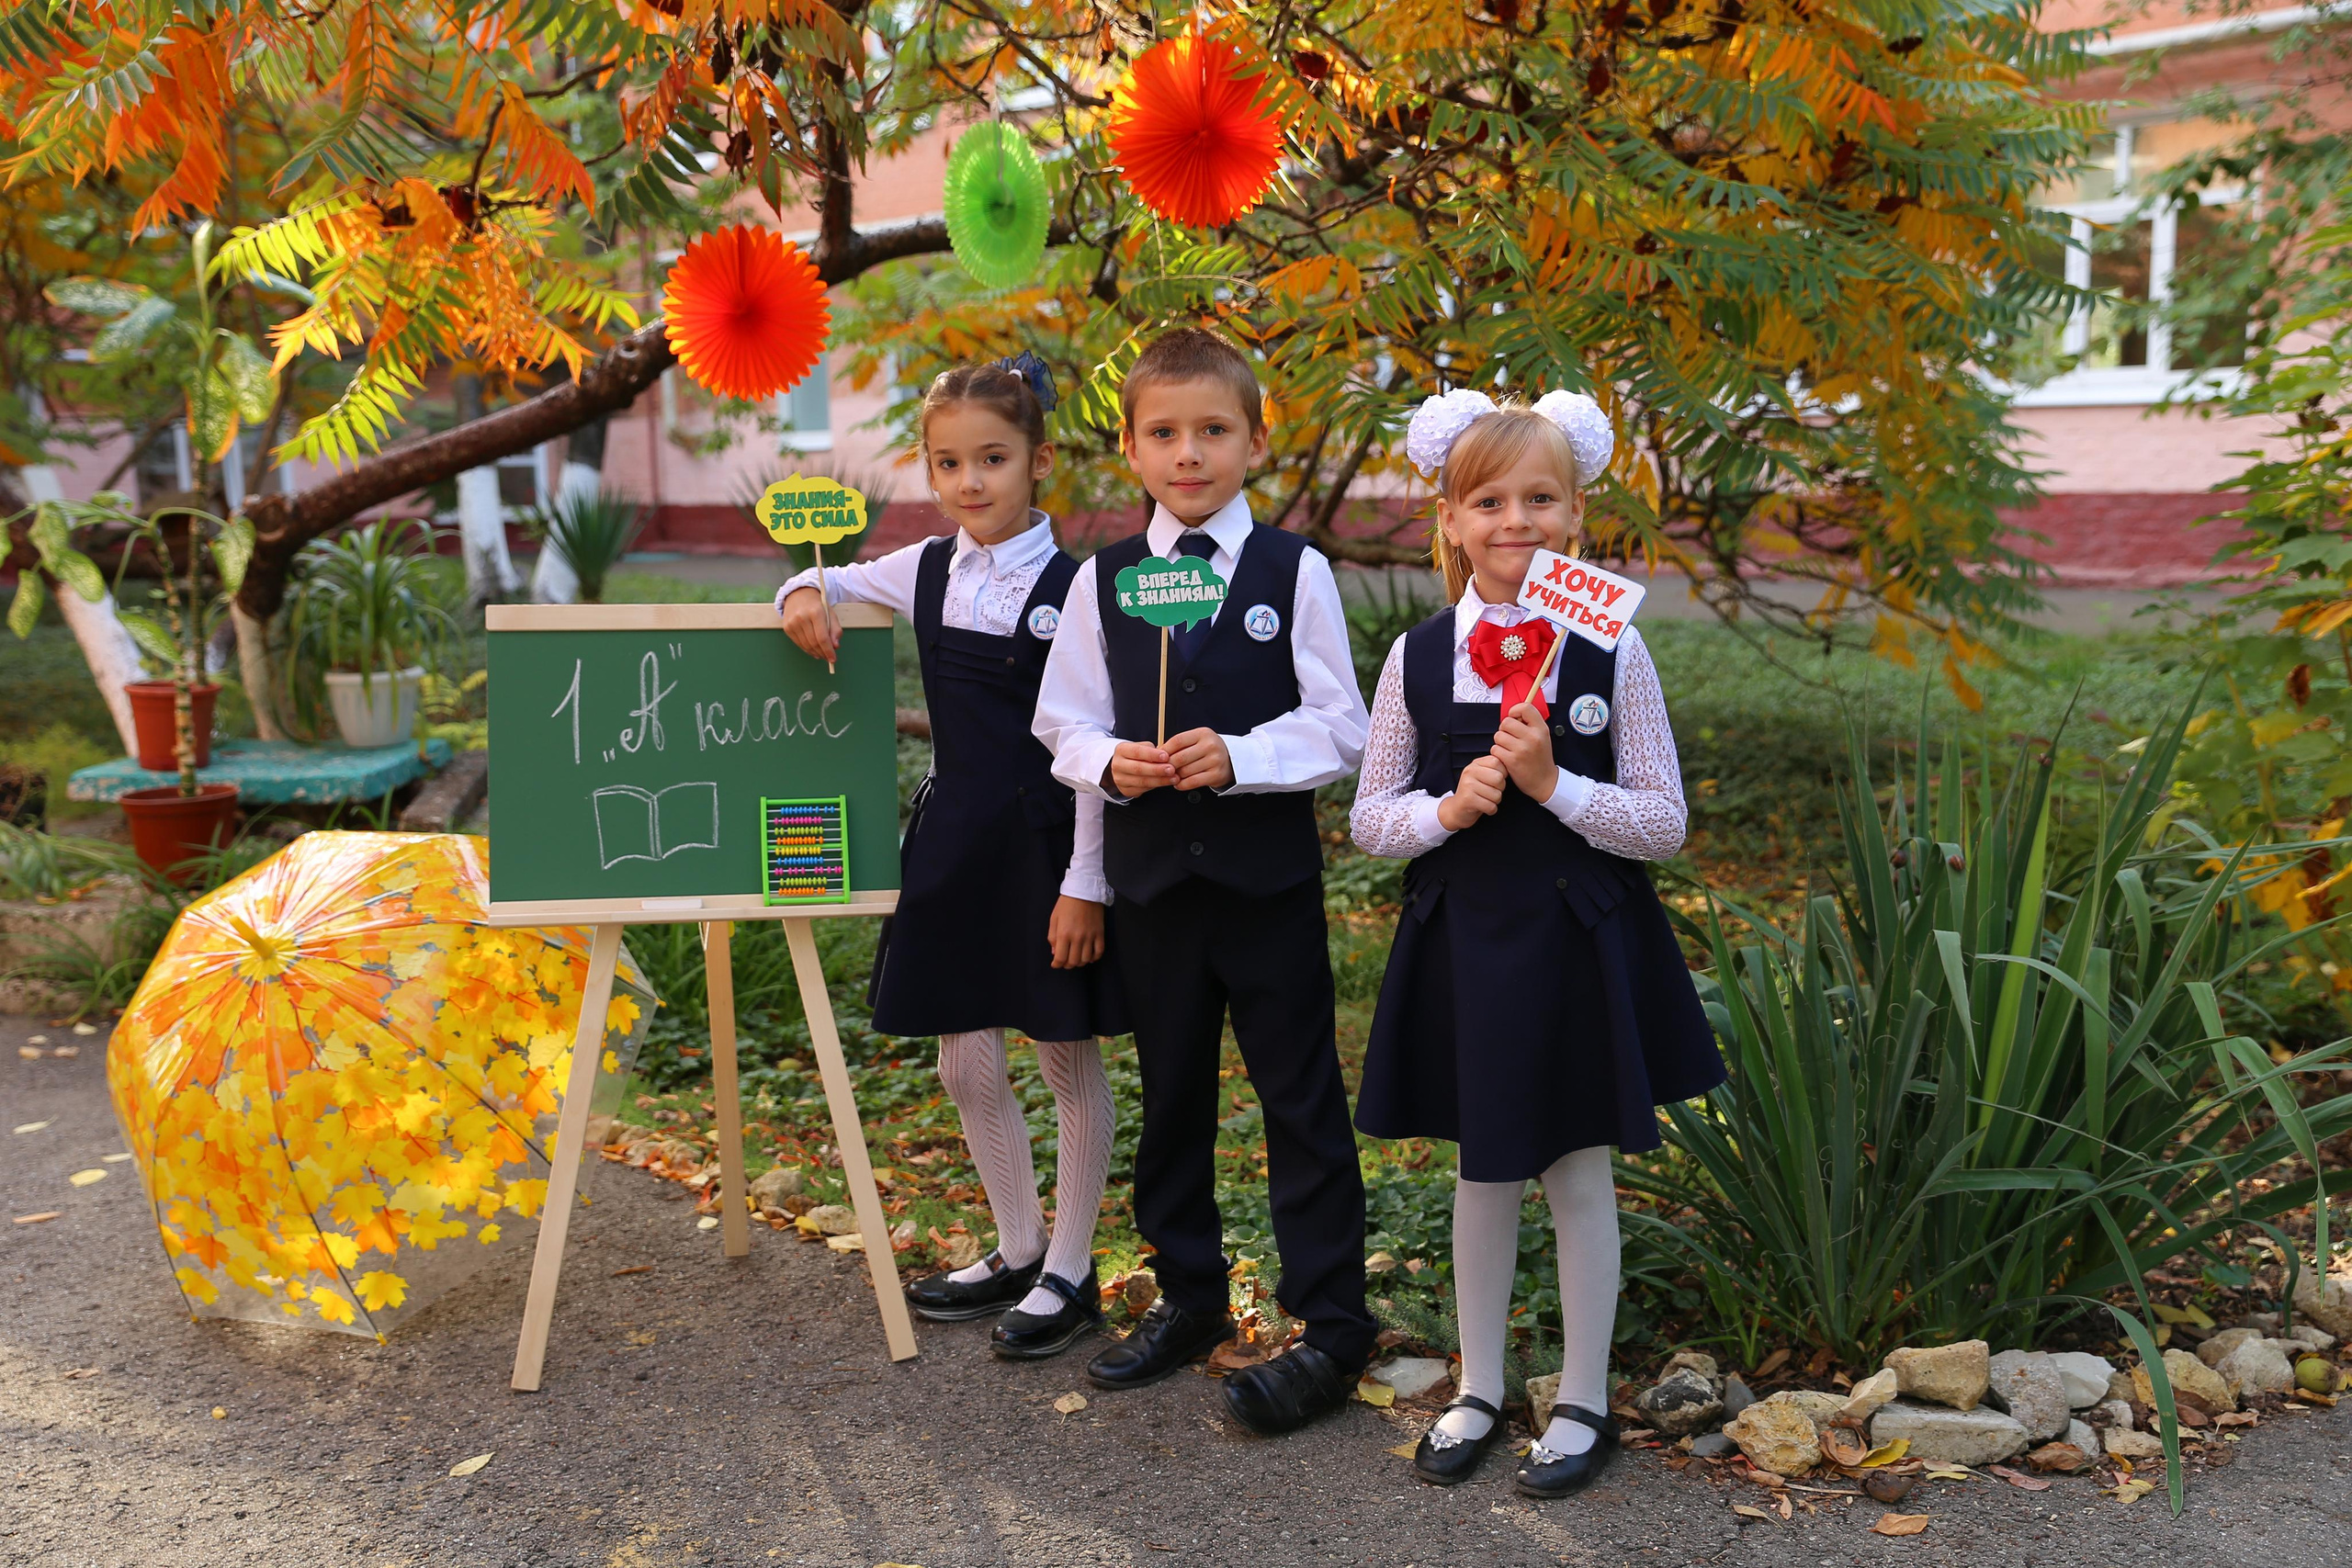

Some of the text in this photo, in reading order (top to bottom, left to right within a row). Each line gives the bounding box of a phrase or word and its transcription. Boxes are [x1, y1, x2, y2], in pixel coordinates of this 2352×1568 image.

[772, 490, 853, 510] ЗНАНИЯ-
[769, 509, 859, 530] ЭТО СИЛА
[1137, 570, 1204, 590] ВПЕРЕД
[1544, 558, 1626, 608] ХОЧУ
[1120, 584, 1224, 607] К ЗНАНИЯМ!
[1524, 581, 1623, 639] УЧИТЬСЯ
[551, 659, 582, 764] 1
[695, 690, 853, 751] класс
